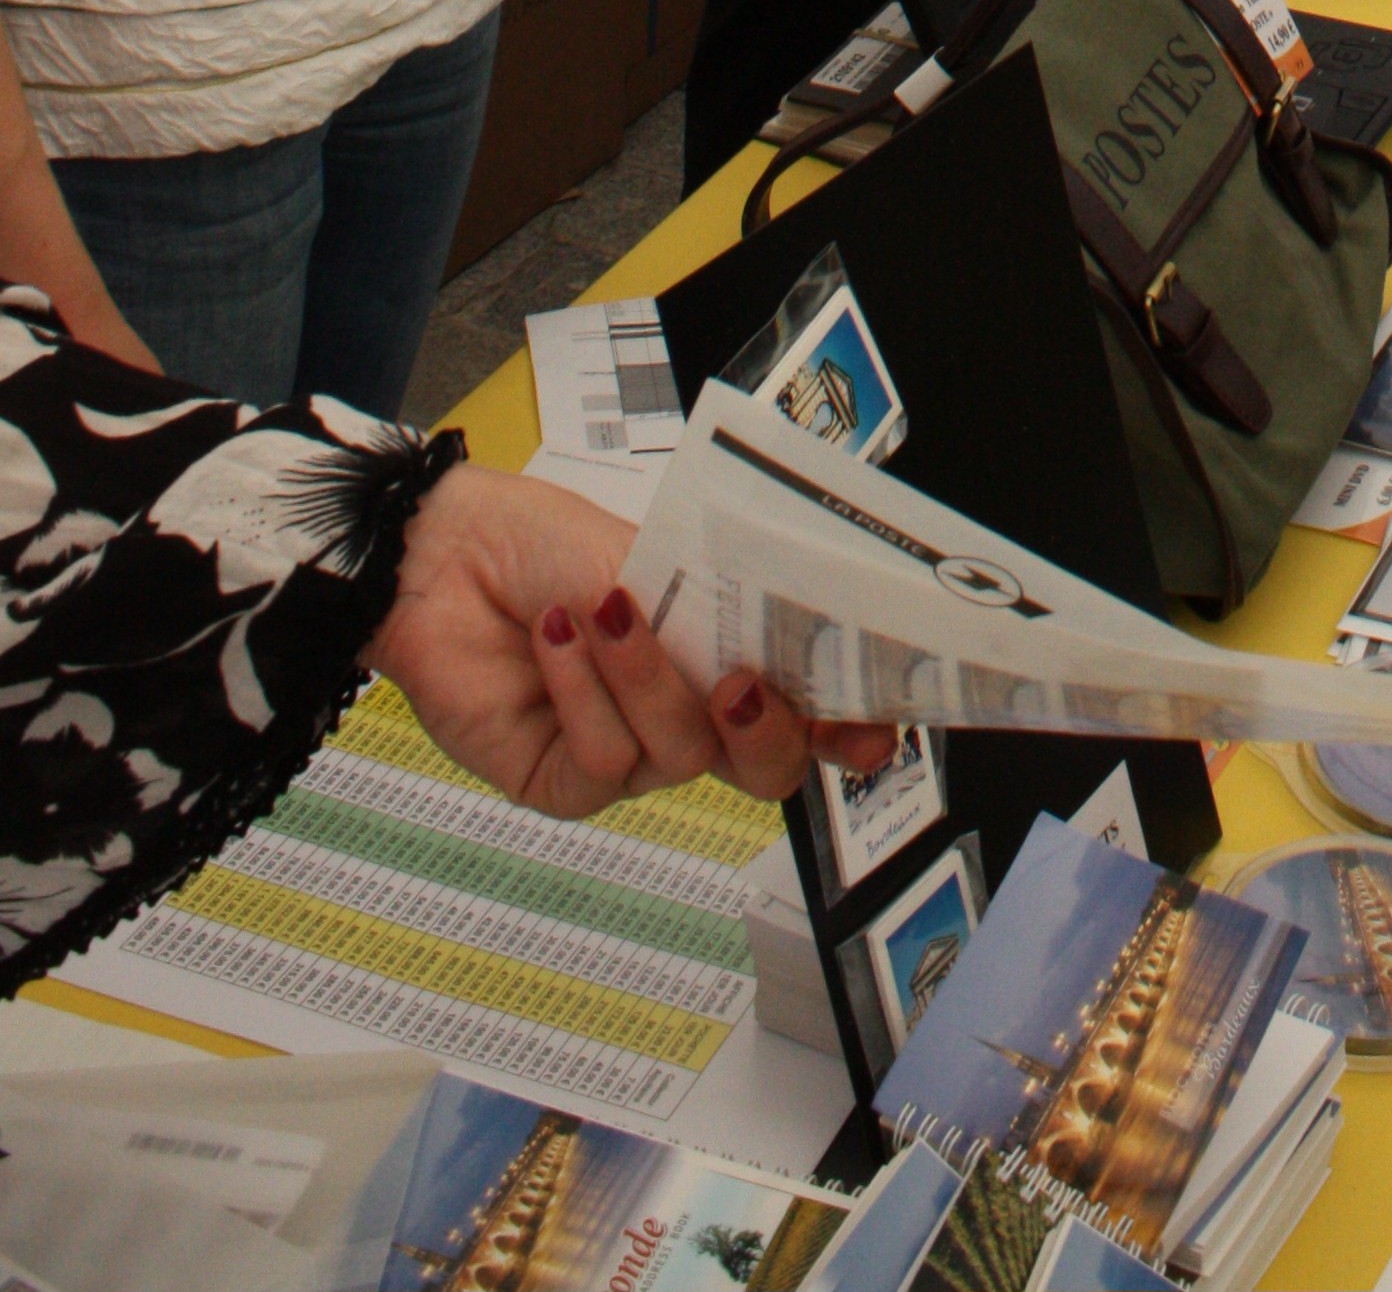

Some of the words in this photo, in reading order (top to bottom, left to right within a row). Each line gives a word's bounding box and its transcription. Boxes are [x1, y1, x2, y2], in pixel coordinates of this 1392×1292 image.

[1250, 10, 1270, 31] OSTE
[1286, 18, 1297, 35] €
[1082, 33, 1216, 210] POSTES
[1333, 484, 1357, 507] MINI
[1349, 463, 1370, 485] DVD
[819, 492, 850, 521] LA
[851, 511, 929, 558] POSTE
[866, 802, 920, 860] Bordeaux
[1194, 979, 1260, 1081] Bordeaux
[609, 1216, 668, 1292] onde
[669, 1212, 692, 1240] BOOK
